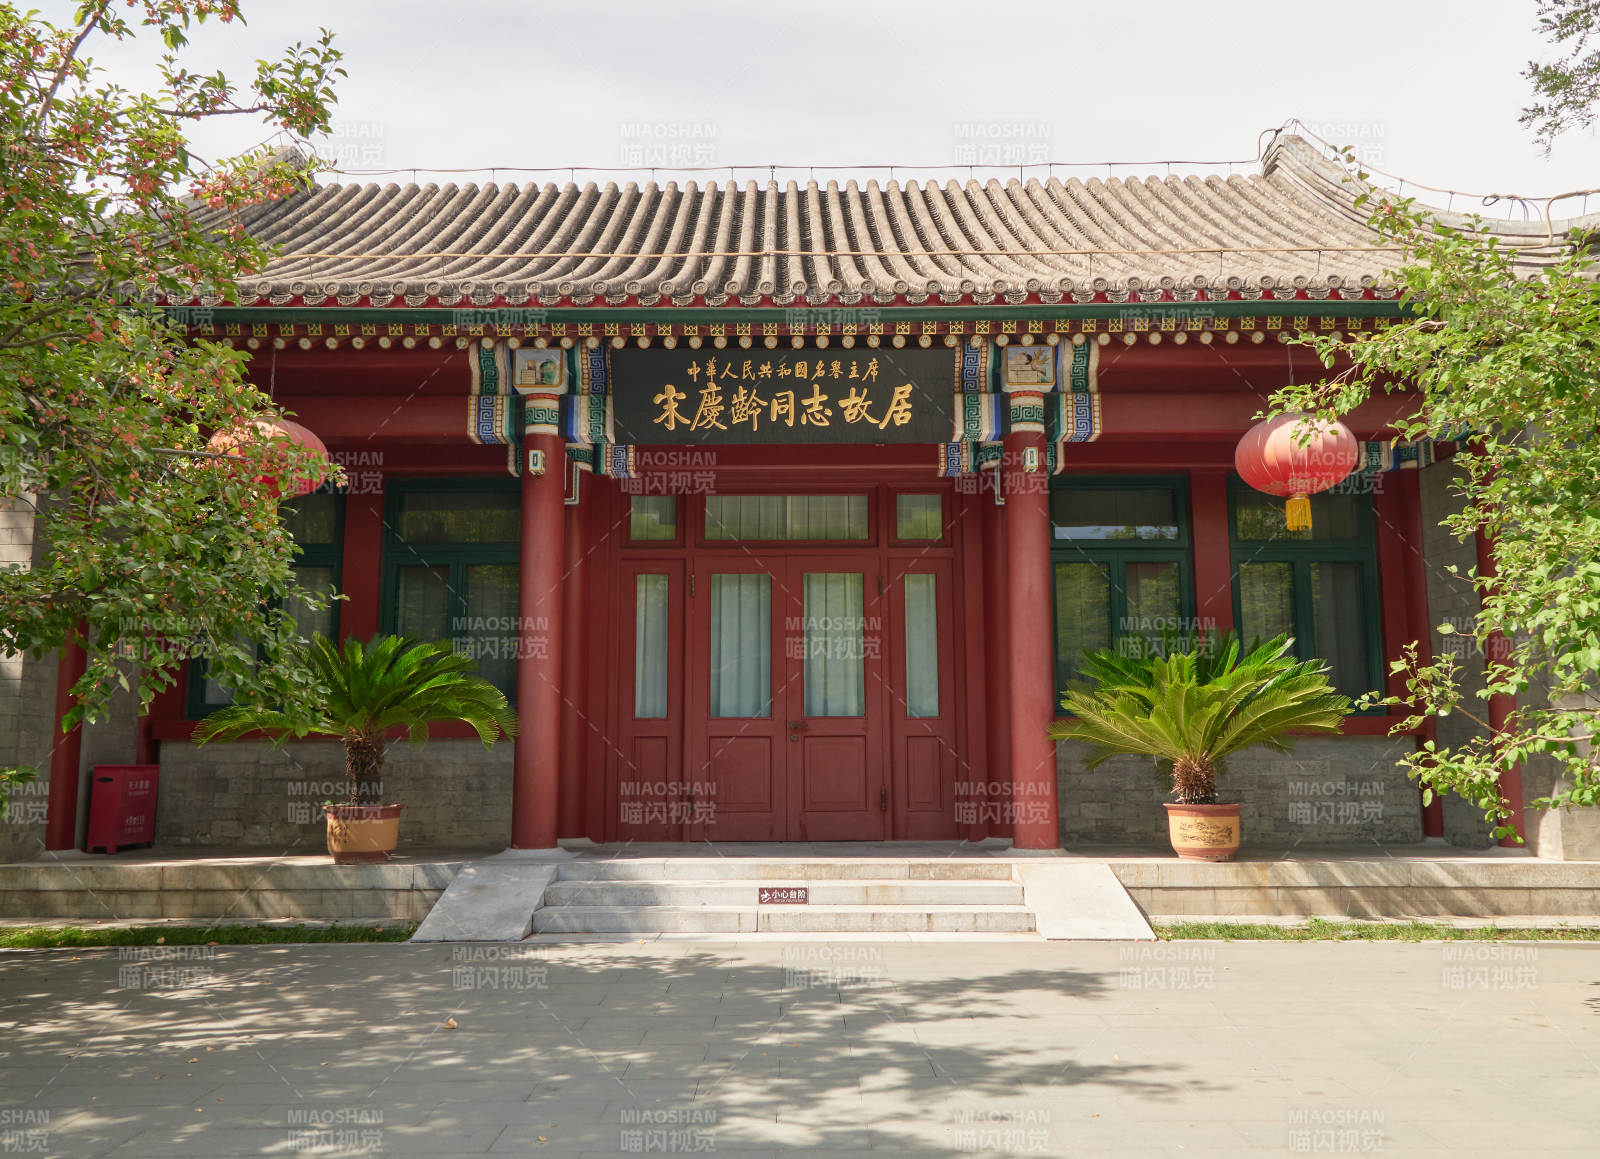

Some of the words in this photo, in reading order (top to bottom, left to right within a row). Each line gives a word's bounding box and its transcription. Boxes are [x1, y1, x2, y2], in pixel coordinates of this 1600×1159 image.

[652, 382, 914, 431] 宋慶齡同志故居
[771, 889, 806, 899] 小心台阶
